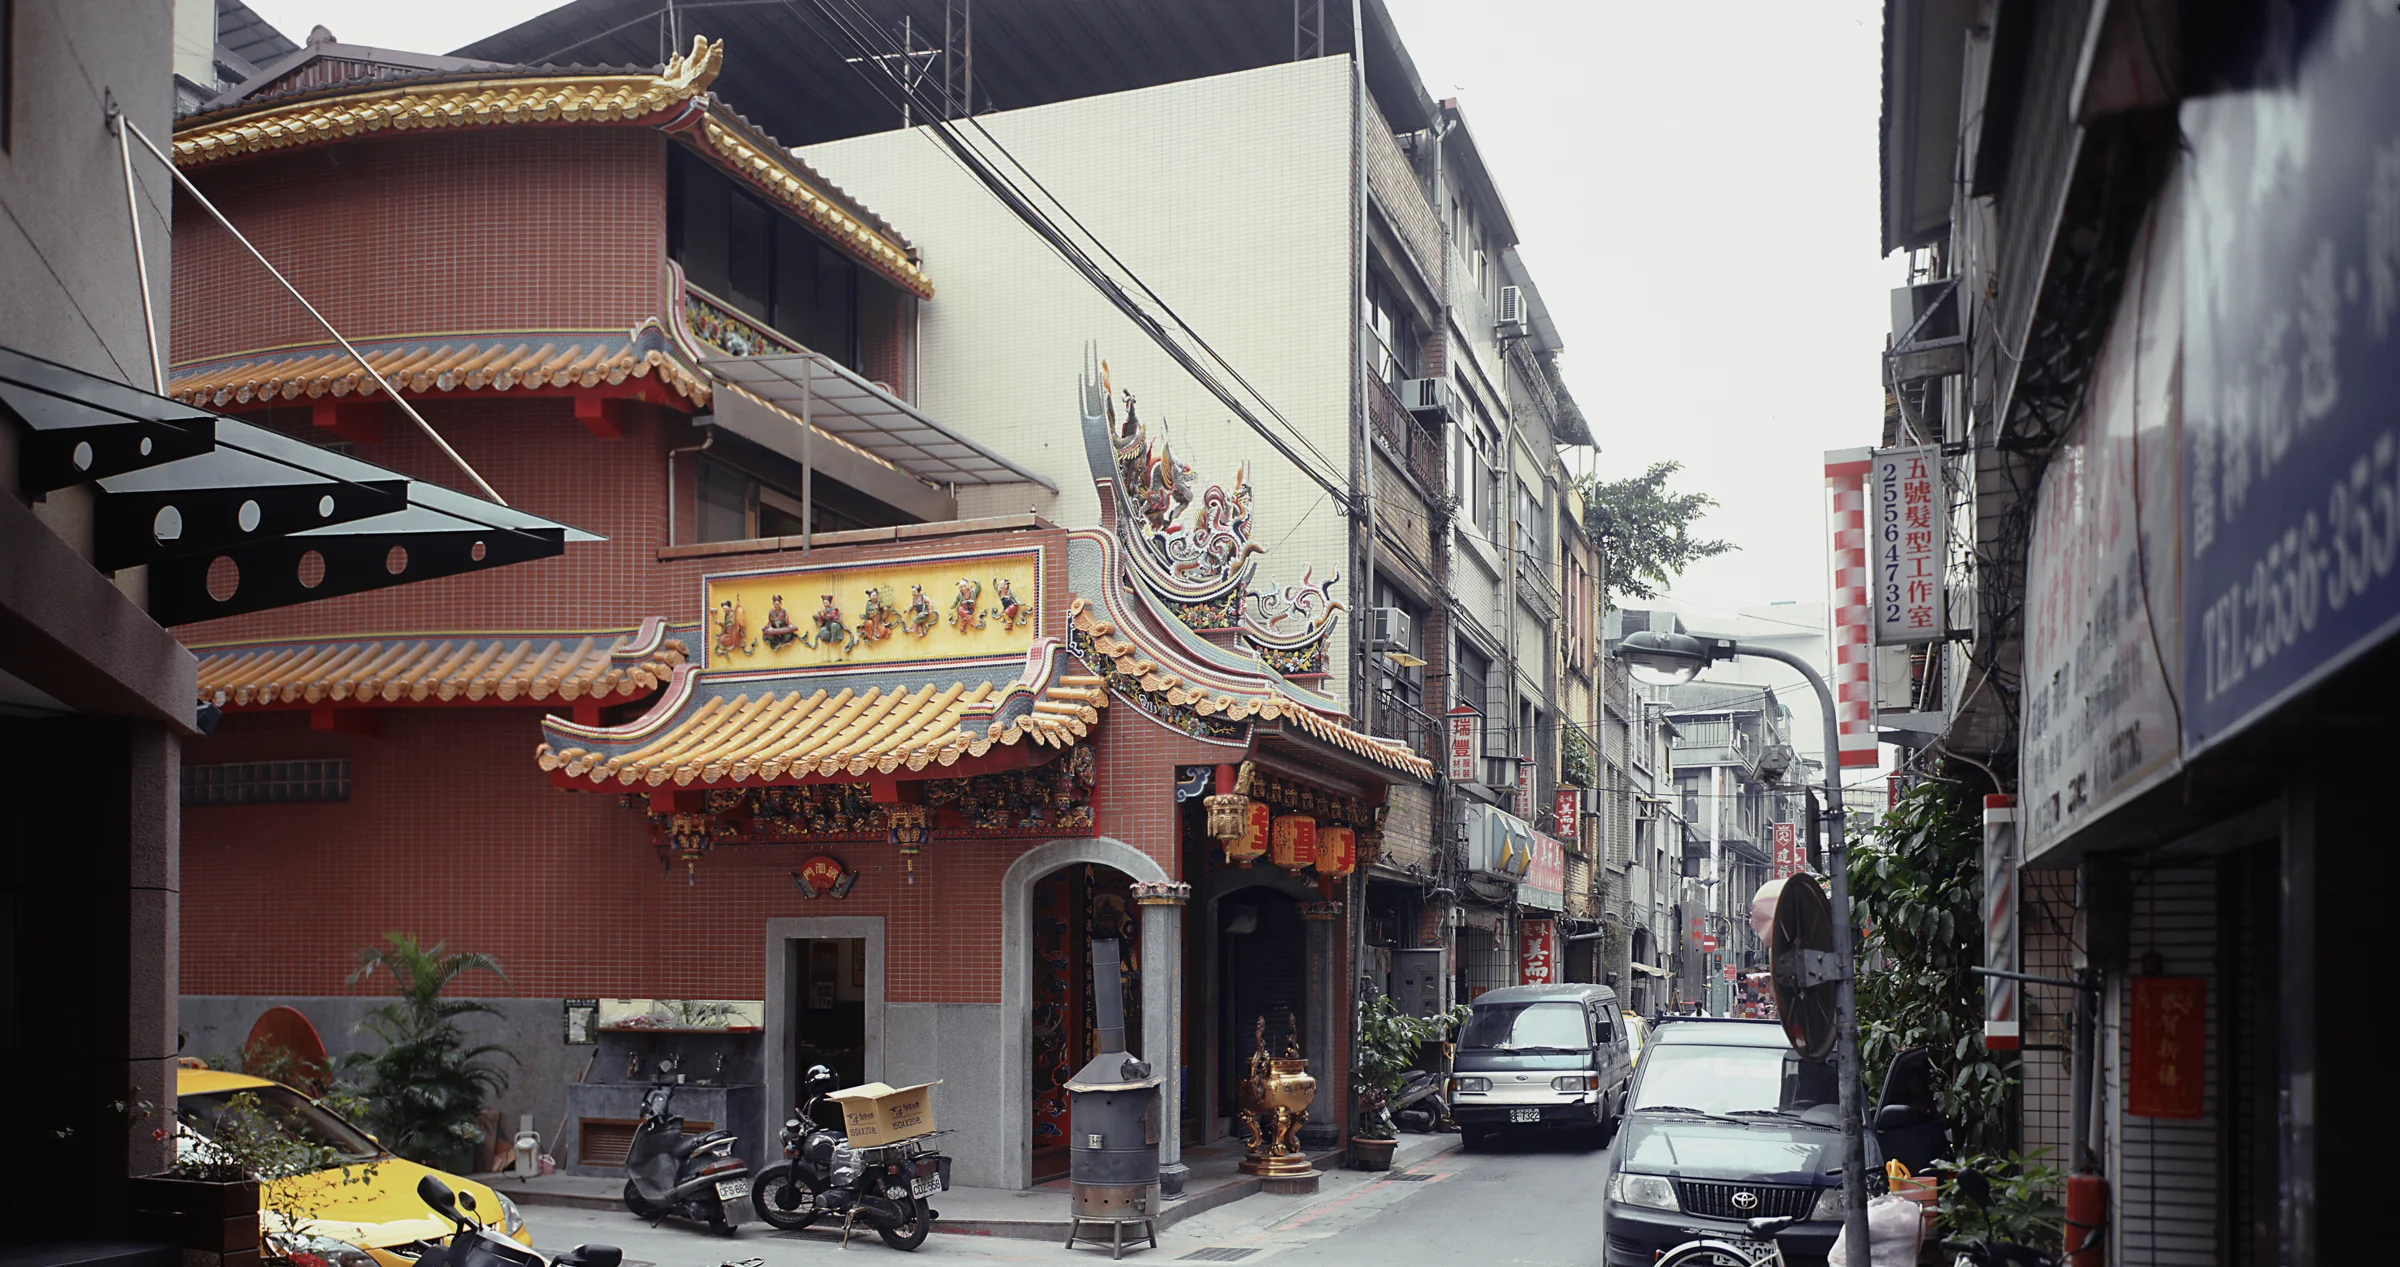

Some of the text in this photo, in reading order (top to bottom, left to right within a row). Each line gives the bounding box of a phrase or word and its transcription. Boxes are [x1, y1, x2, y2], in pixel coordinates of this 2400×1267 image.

[1883, 463, 1901, 623] 25564732
[1904, 456, 1934, 629] 五號髮型工作室
[2201, 428, 2400, 702] TEL:2556-355
[1453, 717, 1471, 757] 瑞豐
[1452, 759, 1461, 778] 材料
[1462, 759, 1471, 778] 服裝
[1558, 803, 1575, 836] 美而美
[1521, 922, 1549, 937] 豪味
